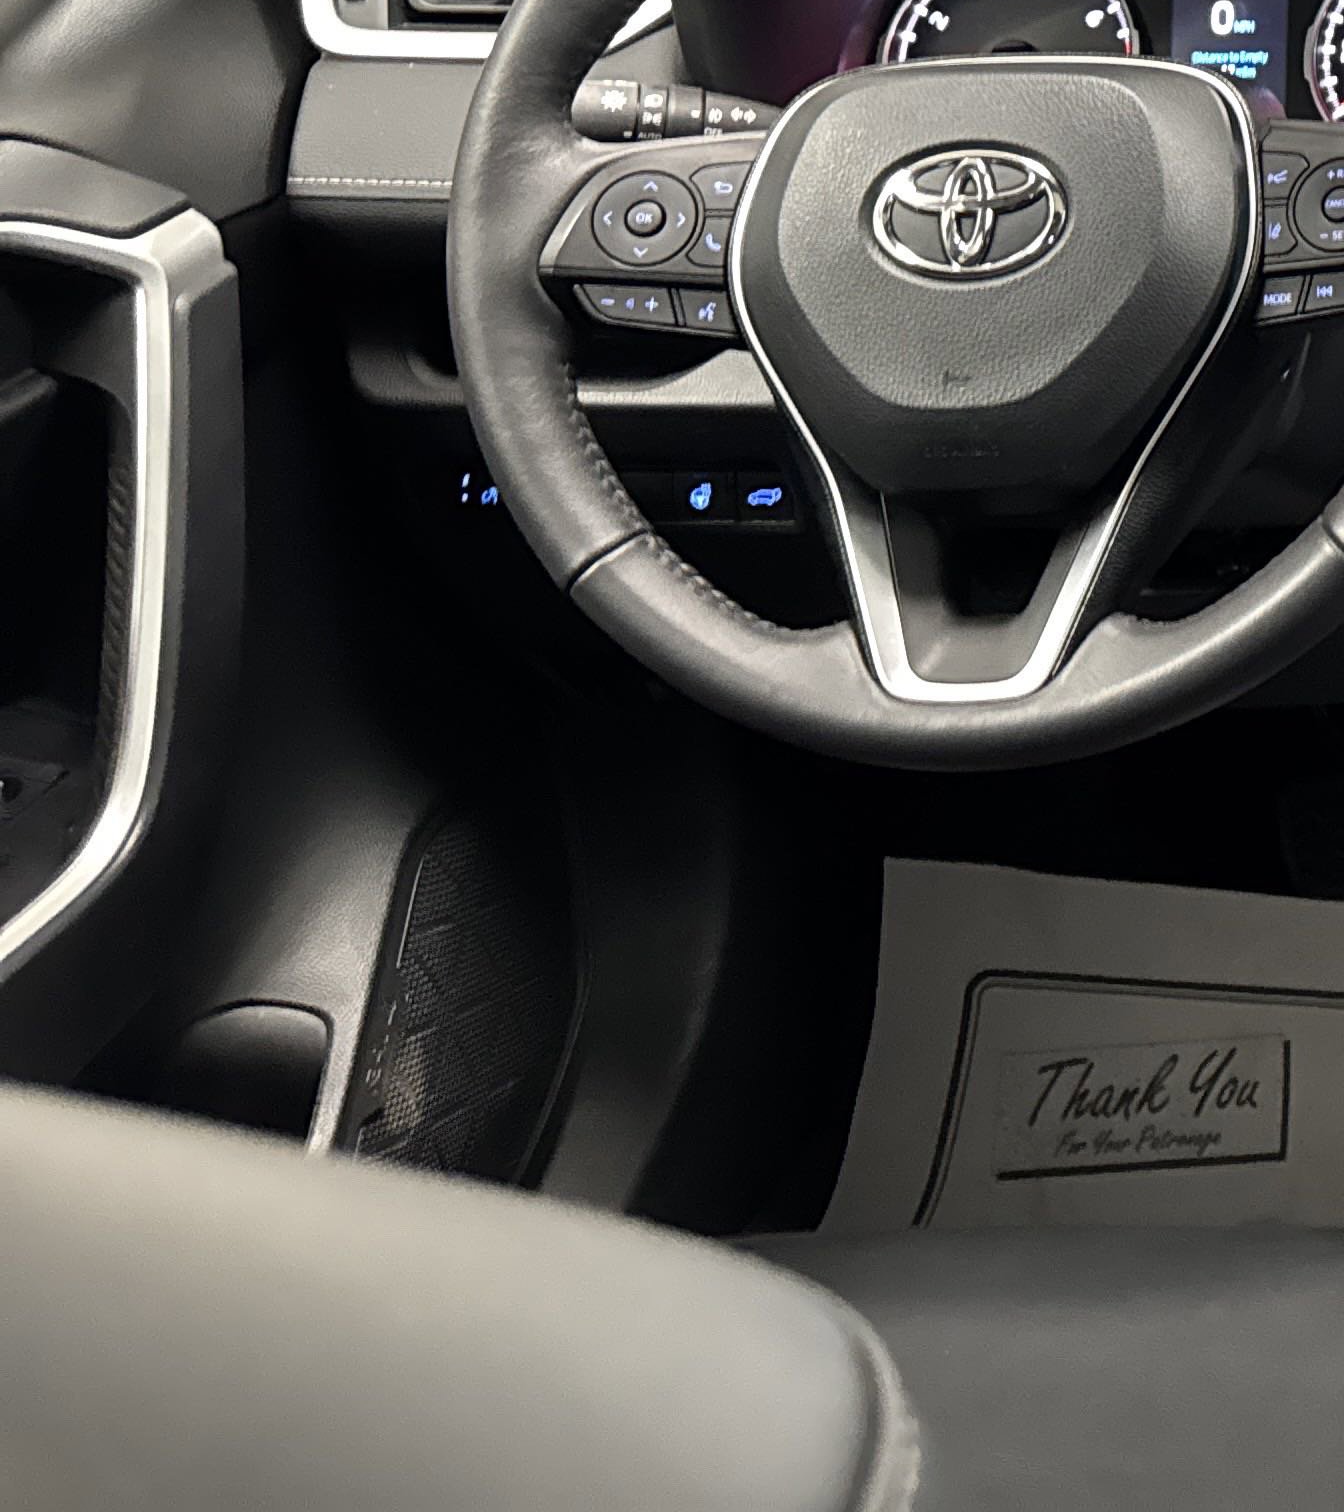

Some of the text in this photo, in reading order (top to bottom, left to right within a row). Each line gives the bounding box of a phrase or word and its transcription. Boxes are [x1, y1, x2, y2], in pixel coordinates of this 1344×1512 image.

[928, 10, 949, 31] 2
[1210, 0, 1235, 36] 0
[635, 212, 653, 225] OK
[1263, 292, 1292, 306] MODE
[1028, 1046, 1261, 1128] Thank You
[1054, 1128, 1087, 1158] For
[1095, 1127, 1131, 1155] Your
